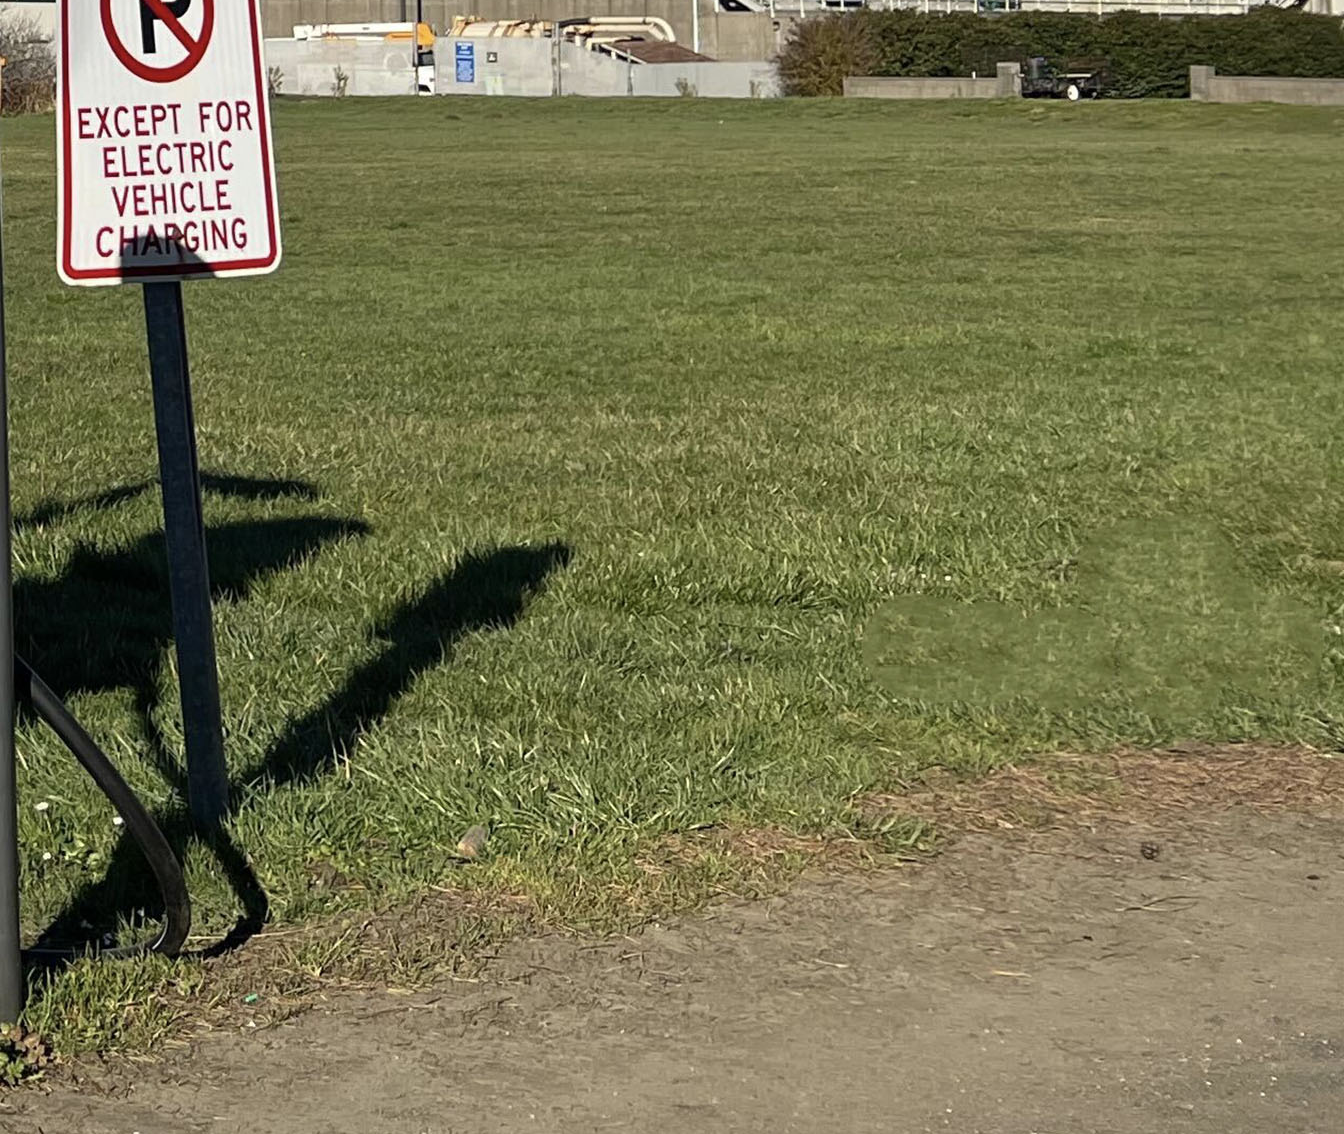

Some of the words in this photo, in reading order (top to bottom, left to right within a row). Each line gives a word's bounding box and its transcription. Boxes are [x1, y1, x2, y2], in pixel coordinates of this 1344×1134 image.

[78, 104, 181, 139] EXCEPT
[199, 101, 253, 133] FOR
[102, 140, 234, 178] ELECTRIC
[111, 180, 232, 217] VEHICLE
[96, 218, 247, 259] CHARGING
